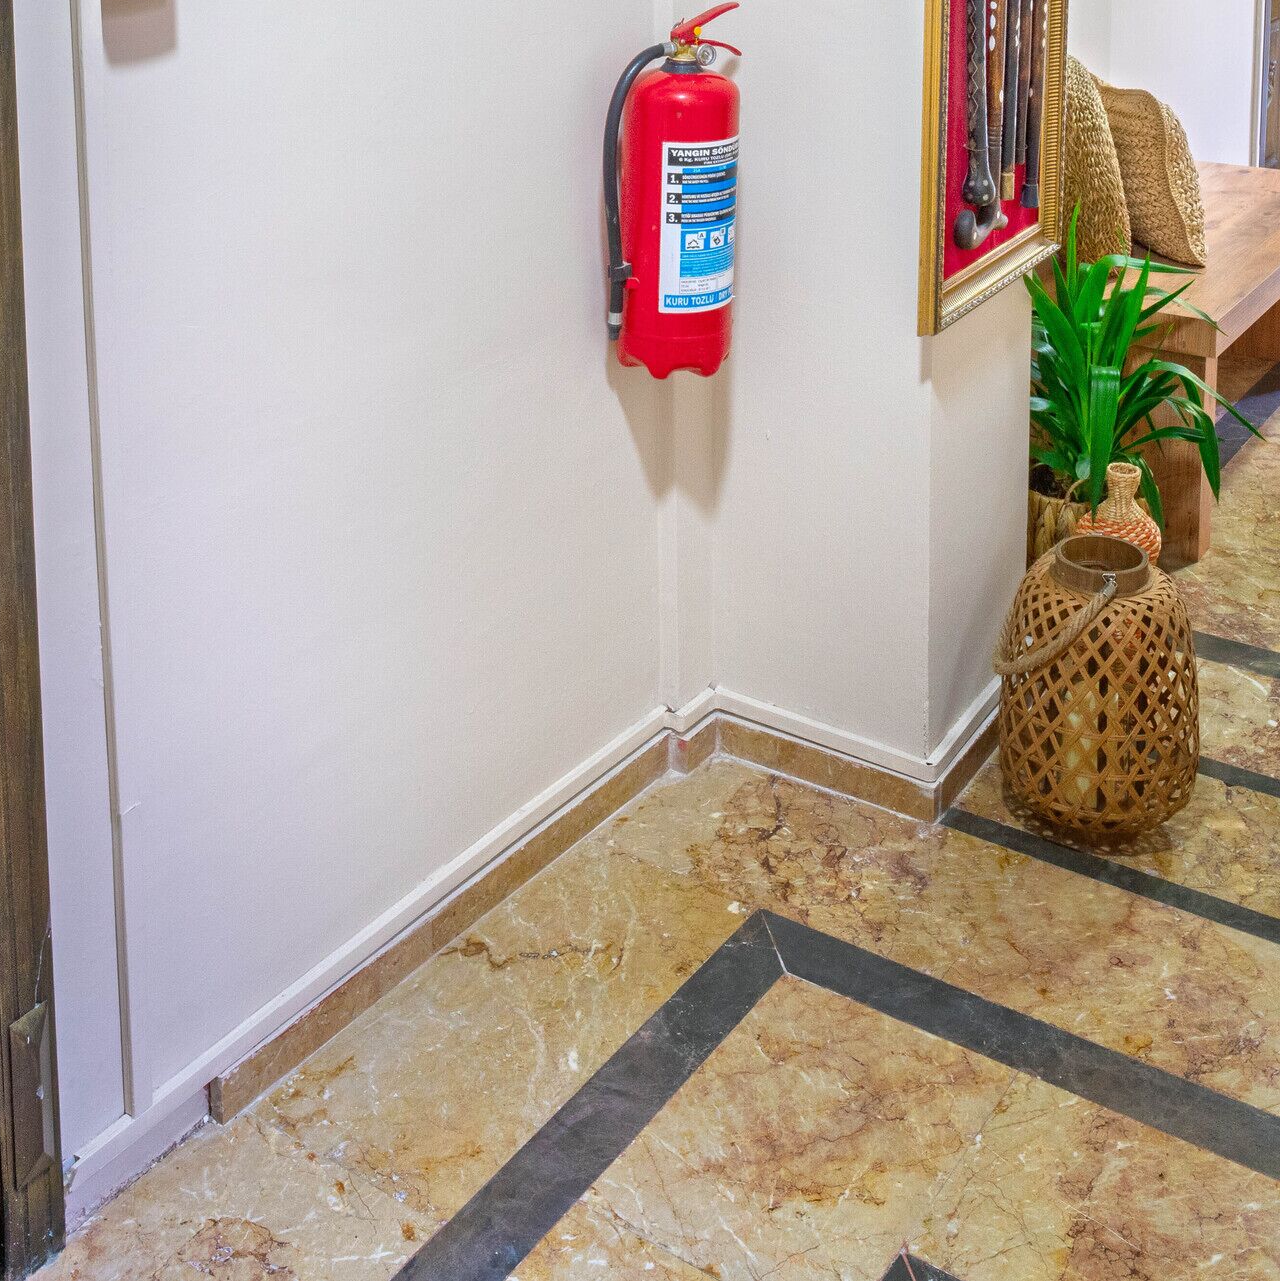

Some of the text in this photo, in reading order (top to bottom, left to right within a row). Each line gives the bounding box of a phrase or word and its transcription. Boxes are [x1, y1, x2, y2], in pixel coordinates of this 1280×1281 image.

[671, 149, 710, 157] YANGIN
[670, 174, 679, 183] 1.
[669, 194, 678, 203] 2.
[668, 213, 678, 222] 3.
[666, 297, 689, 306] KURU
[691, 294, 714, 305] TOZLU
